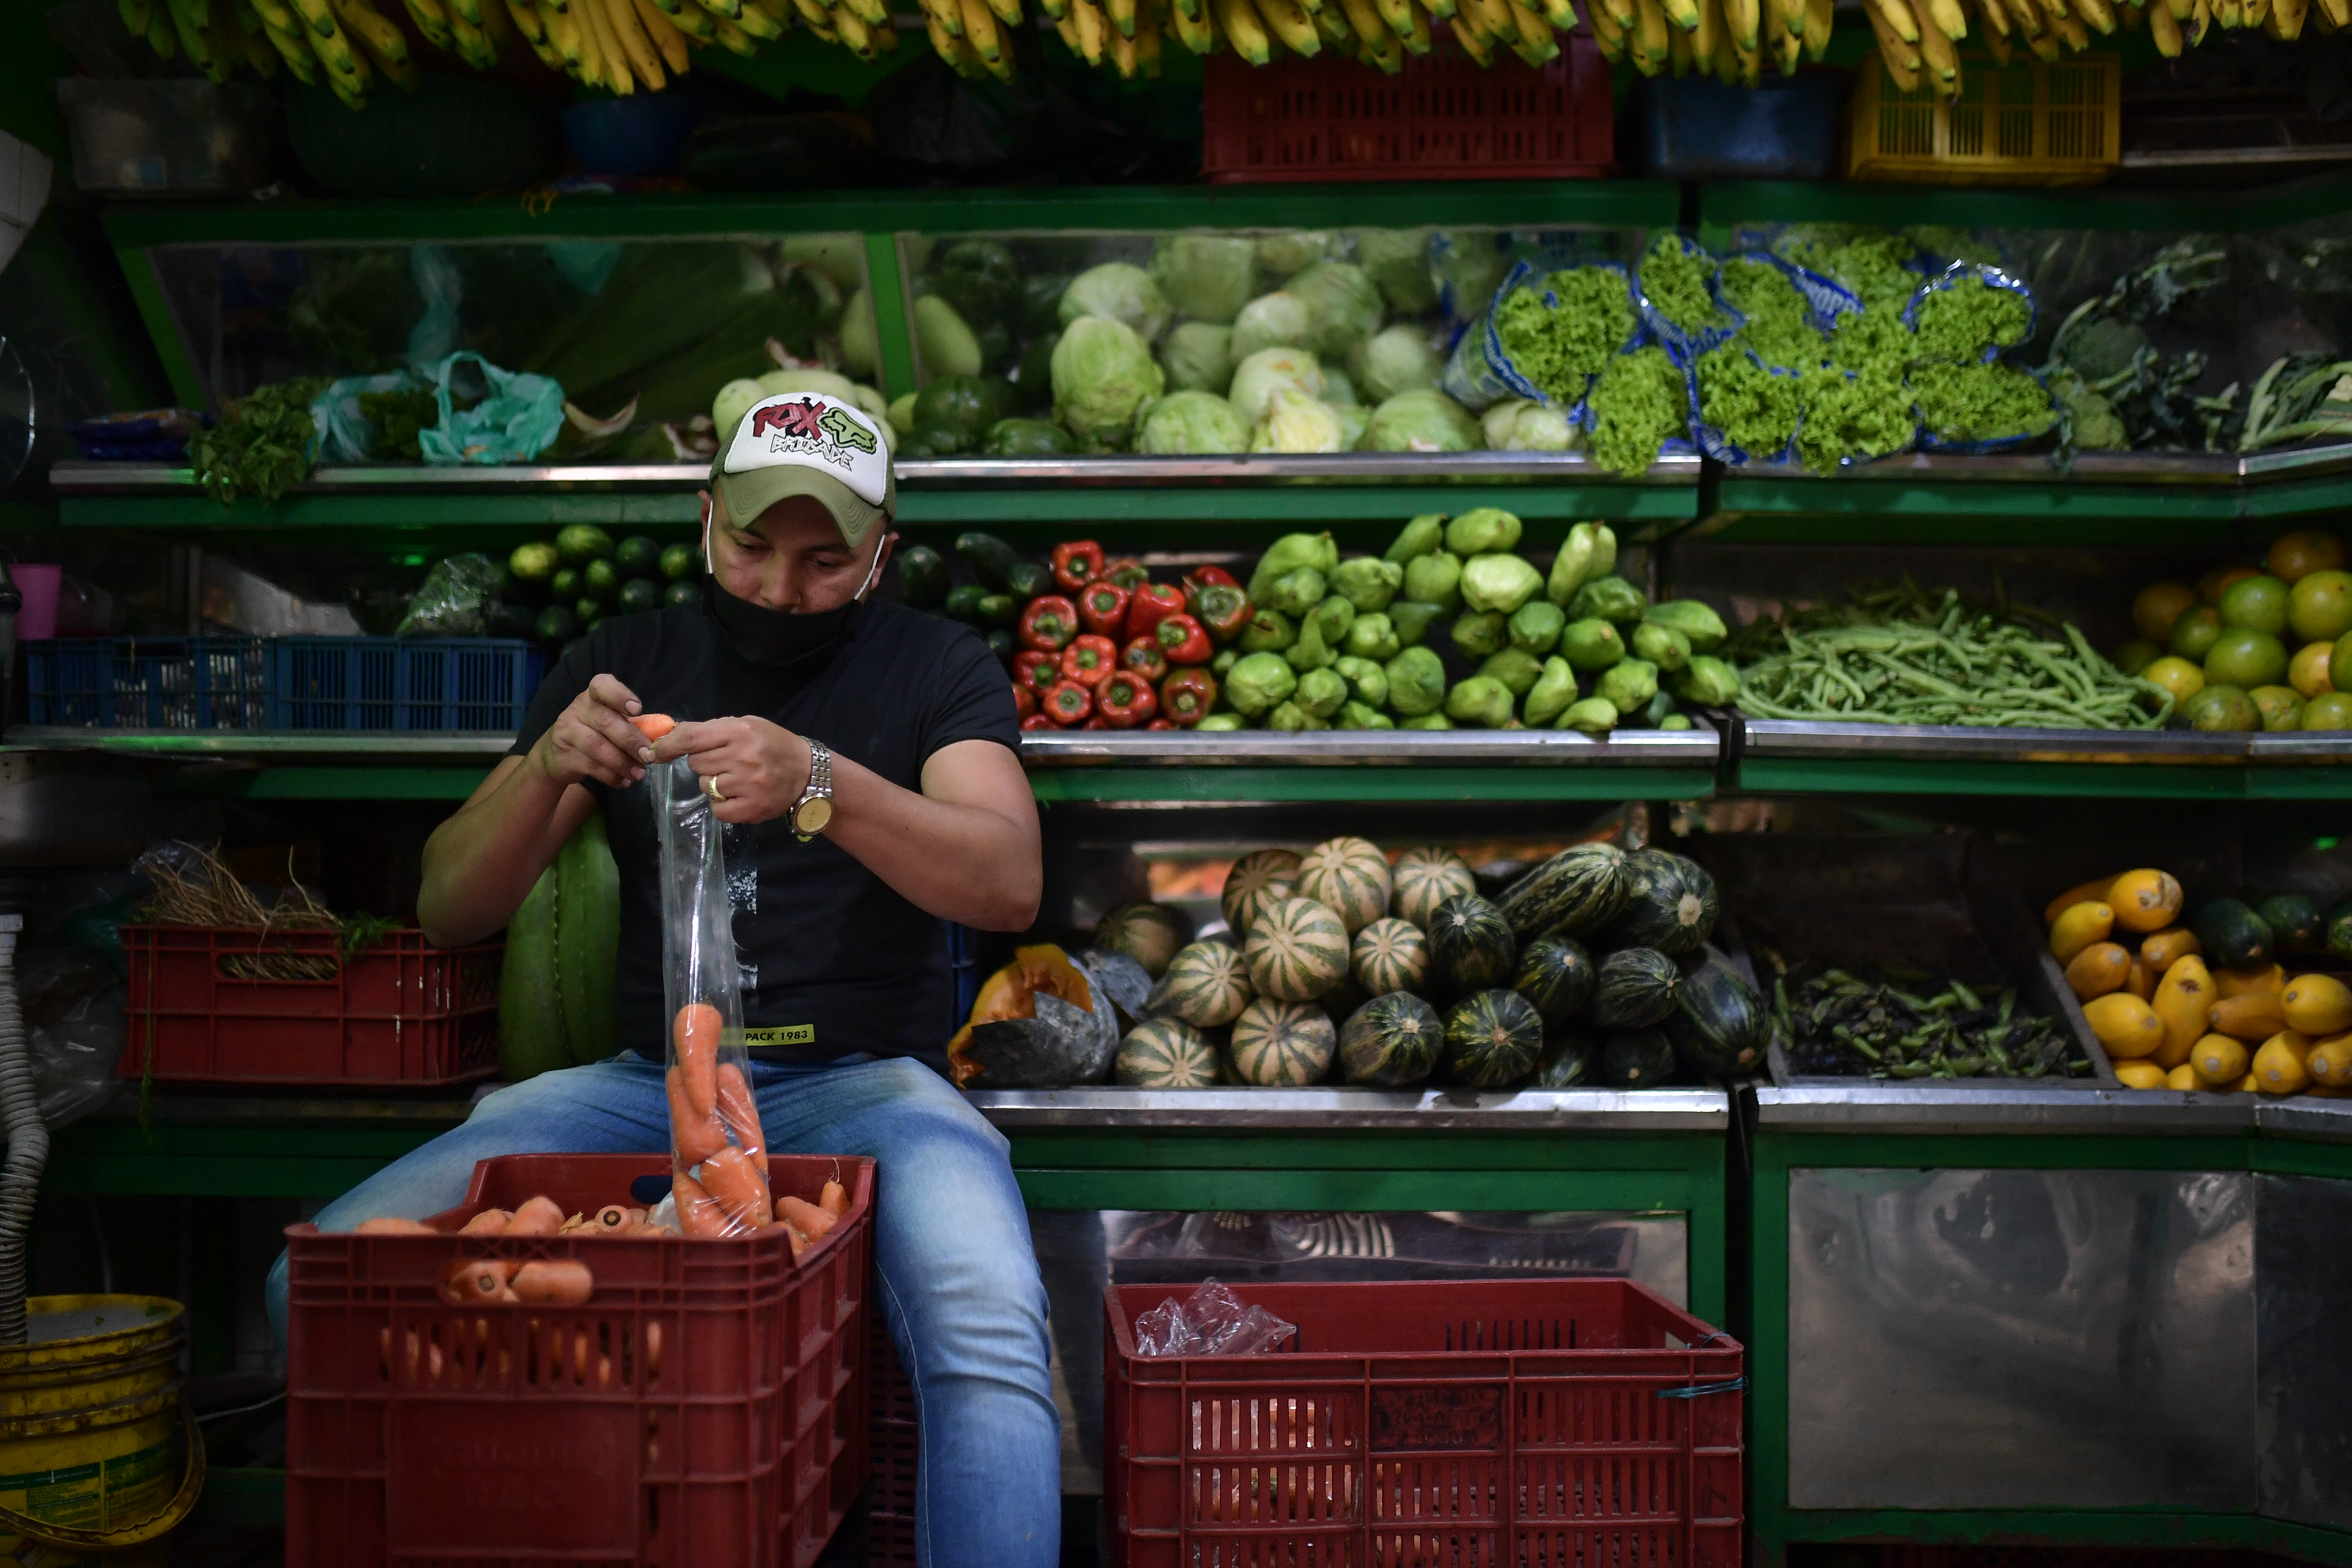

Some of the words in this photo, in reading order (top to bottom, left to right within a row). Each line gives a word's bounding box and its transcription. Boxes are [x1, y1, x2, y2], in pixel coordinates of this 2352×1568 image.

[753, 401, 826, 440] FOX
[770, 434, 854, 471] BRIGADE
[746, 1032, 775, 1041] PACK
[781, 1030, 808, 1040] 1983
